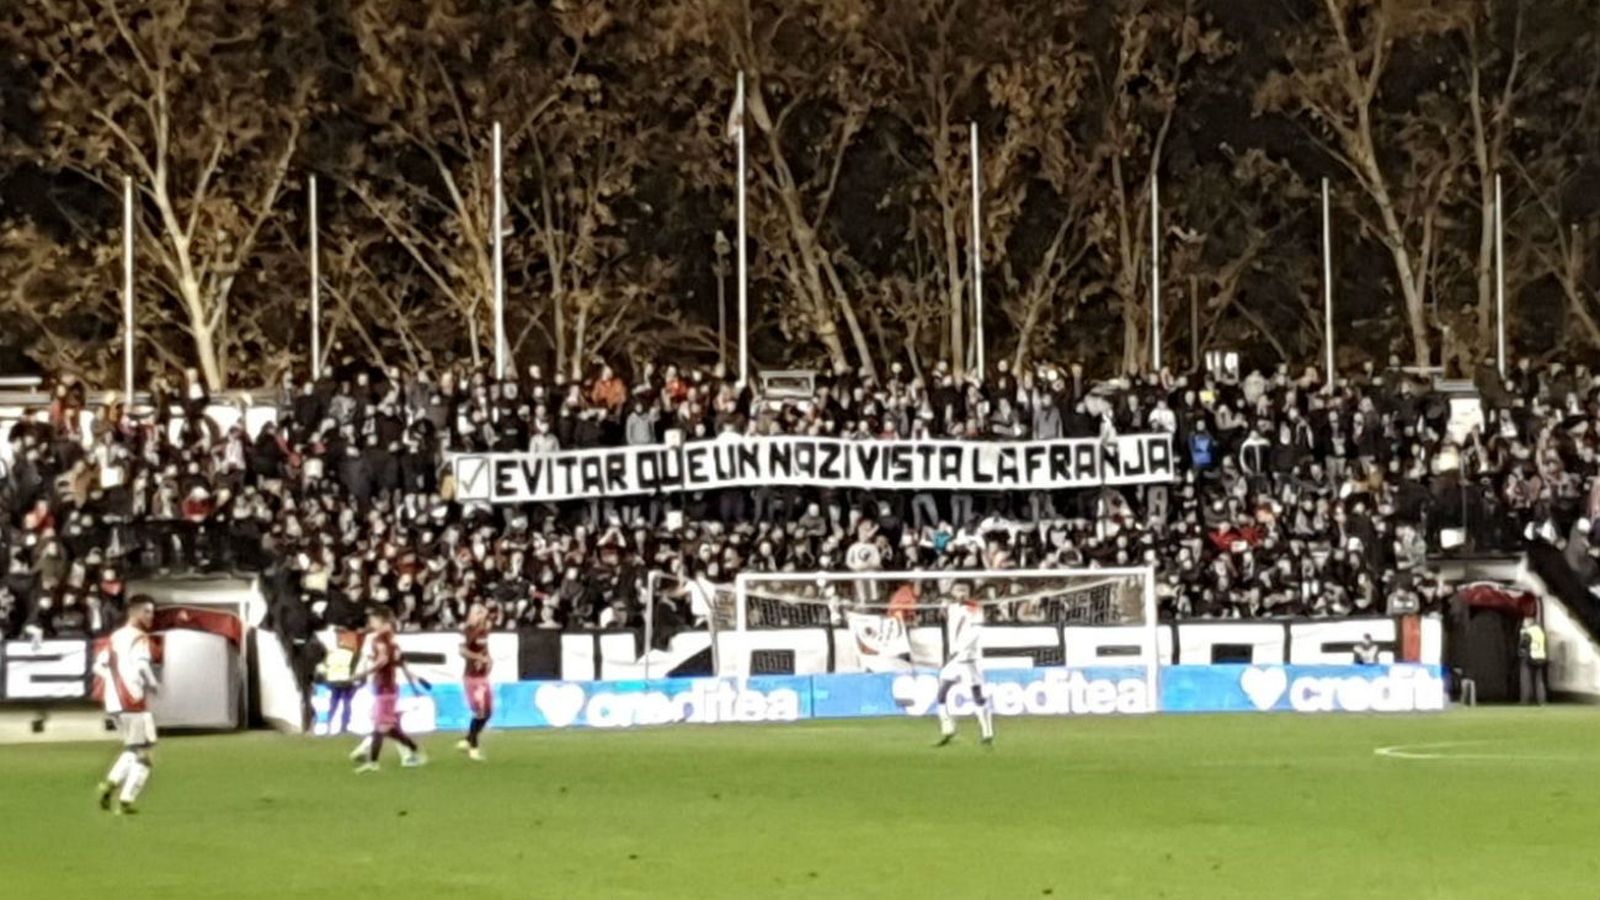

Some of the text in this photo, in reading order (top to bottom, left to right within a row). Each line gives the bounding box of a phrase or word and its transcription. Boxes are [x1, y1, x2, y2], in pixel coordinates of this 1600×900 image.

[494, 438, 1170, 498] EVITAR QUE UN NAZI VISTA LA FRANJA
[586, 677, 799, 728] creditea
[945, 669, 1148, 716] creditea
[1289, 664, 1444, 712] credit
